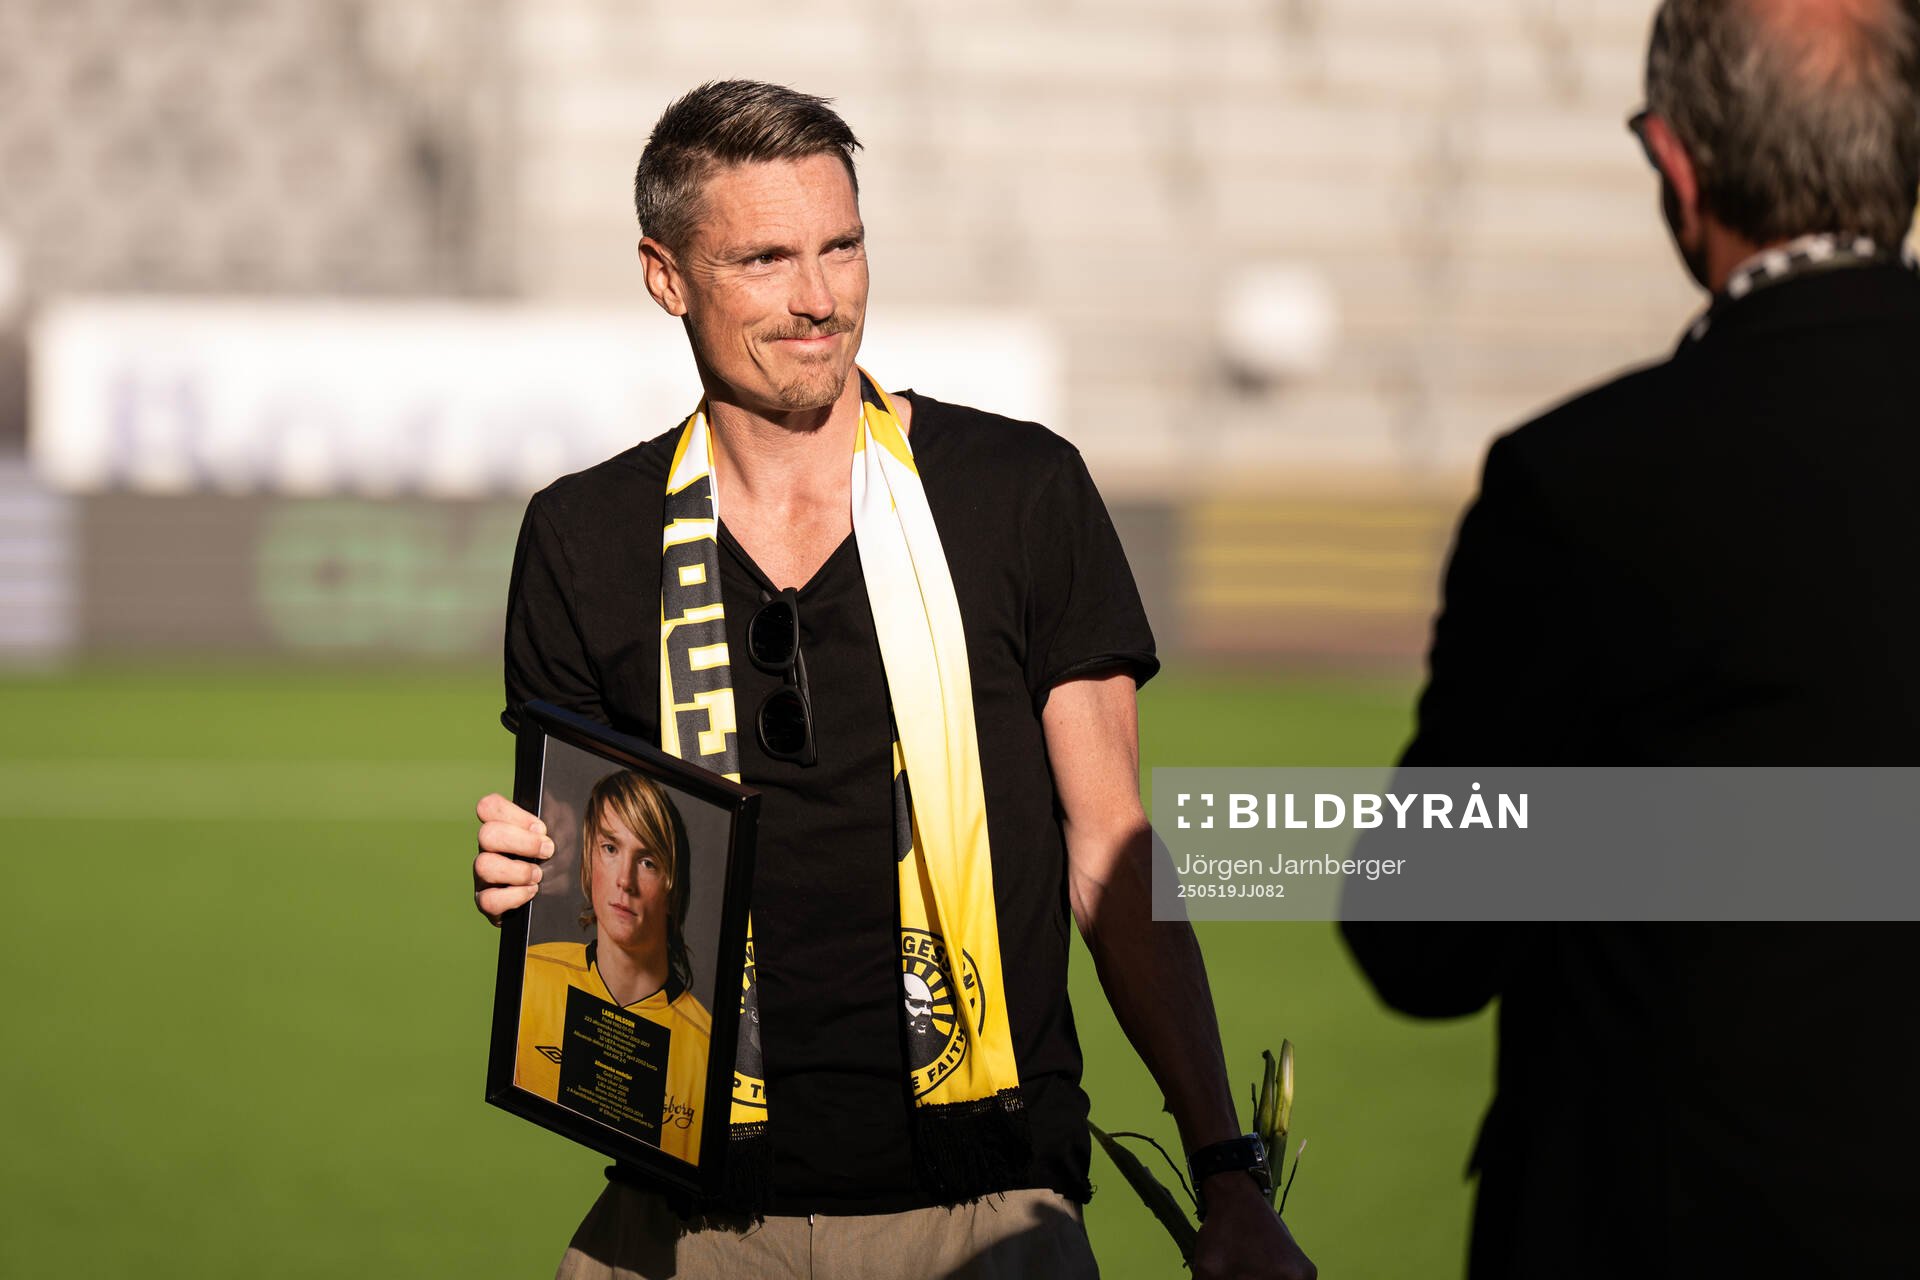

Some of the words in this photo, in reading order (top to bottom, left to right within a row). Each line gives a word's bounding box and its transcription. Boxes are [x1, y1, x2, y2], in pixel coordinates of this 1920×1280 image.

[601, 1008, 614, 1019] LARS
[614, 1014, 635, 1028] NILSSON
[926, 1027, 967, 1083] FAITH
[663, 1095, 695, 1129] sborg
